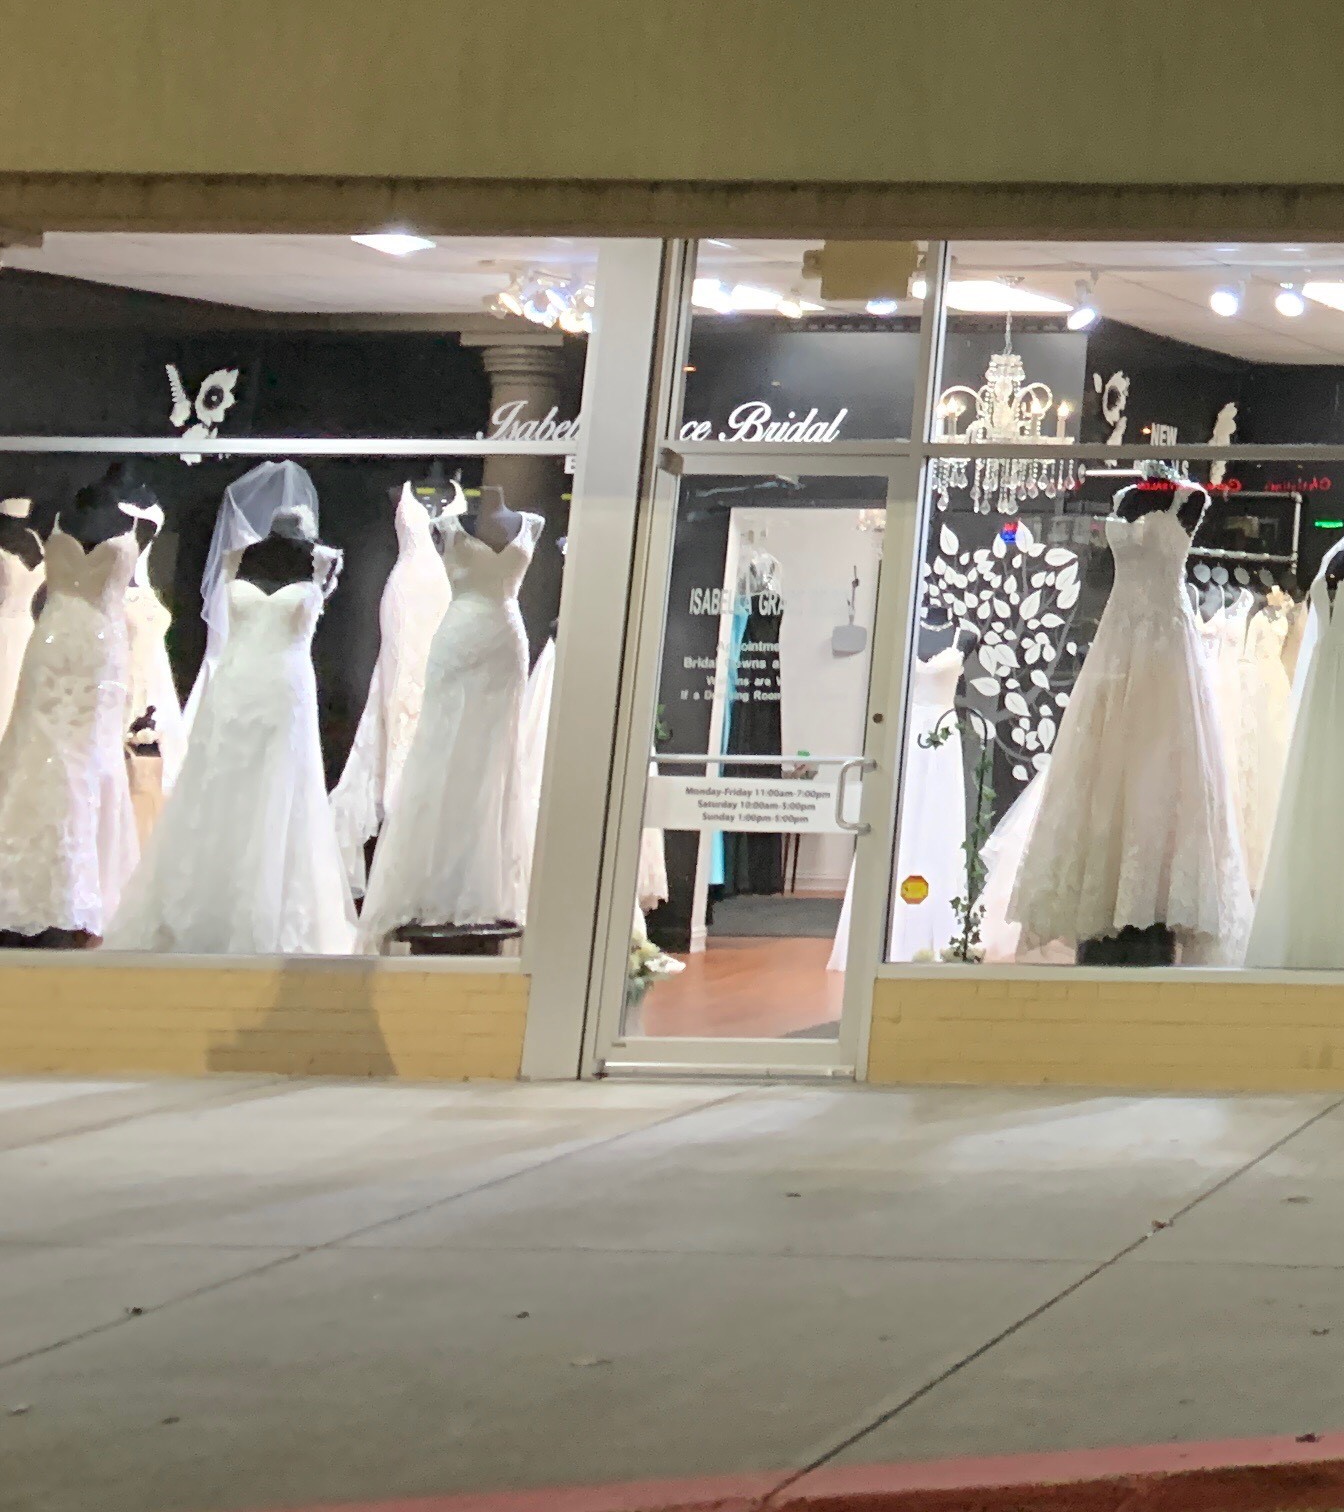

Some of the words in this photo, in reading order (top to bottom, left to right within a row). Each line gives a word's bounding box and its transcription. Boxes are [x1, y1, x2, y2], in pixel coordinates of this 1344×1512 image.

[475, 400, 582, 440] Isabel
[718, 400, 849, 443] Bridal
[1150, 422, 1178, 446] NEW
[697, 799, 738, 810] Saturday
[702, 811, 735, 823] Sunday
